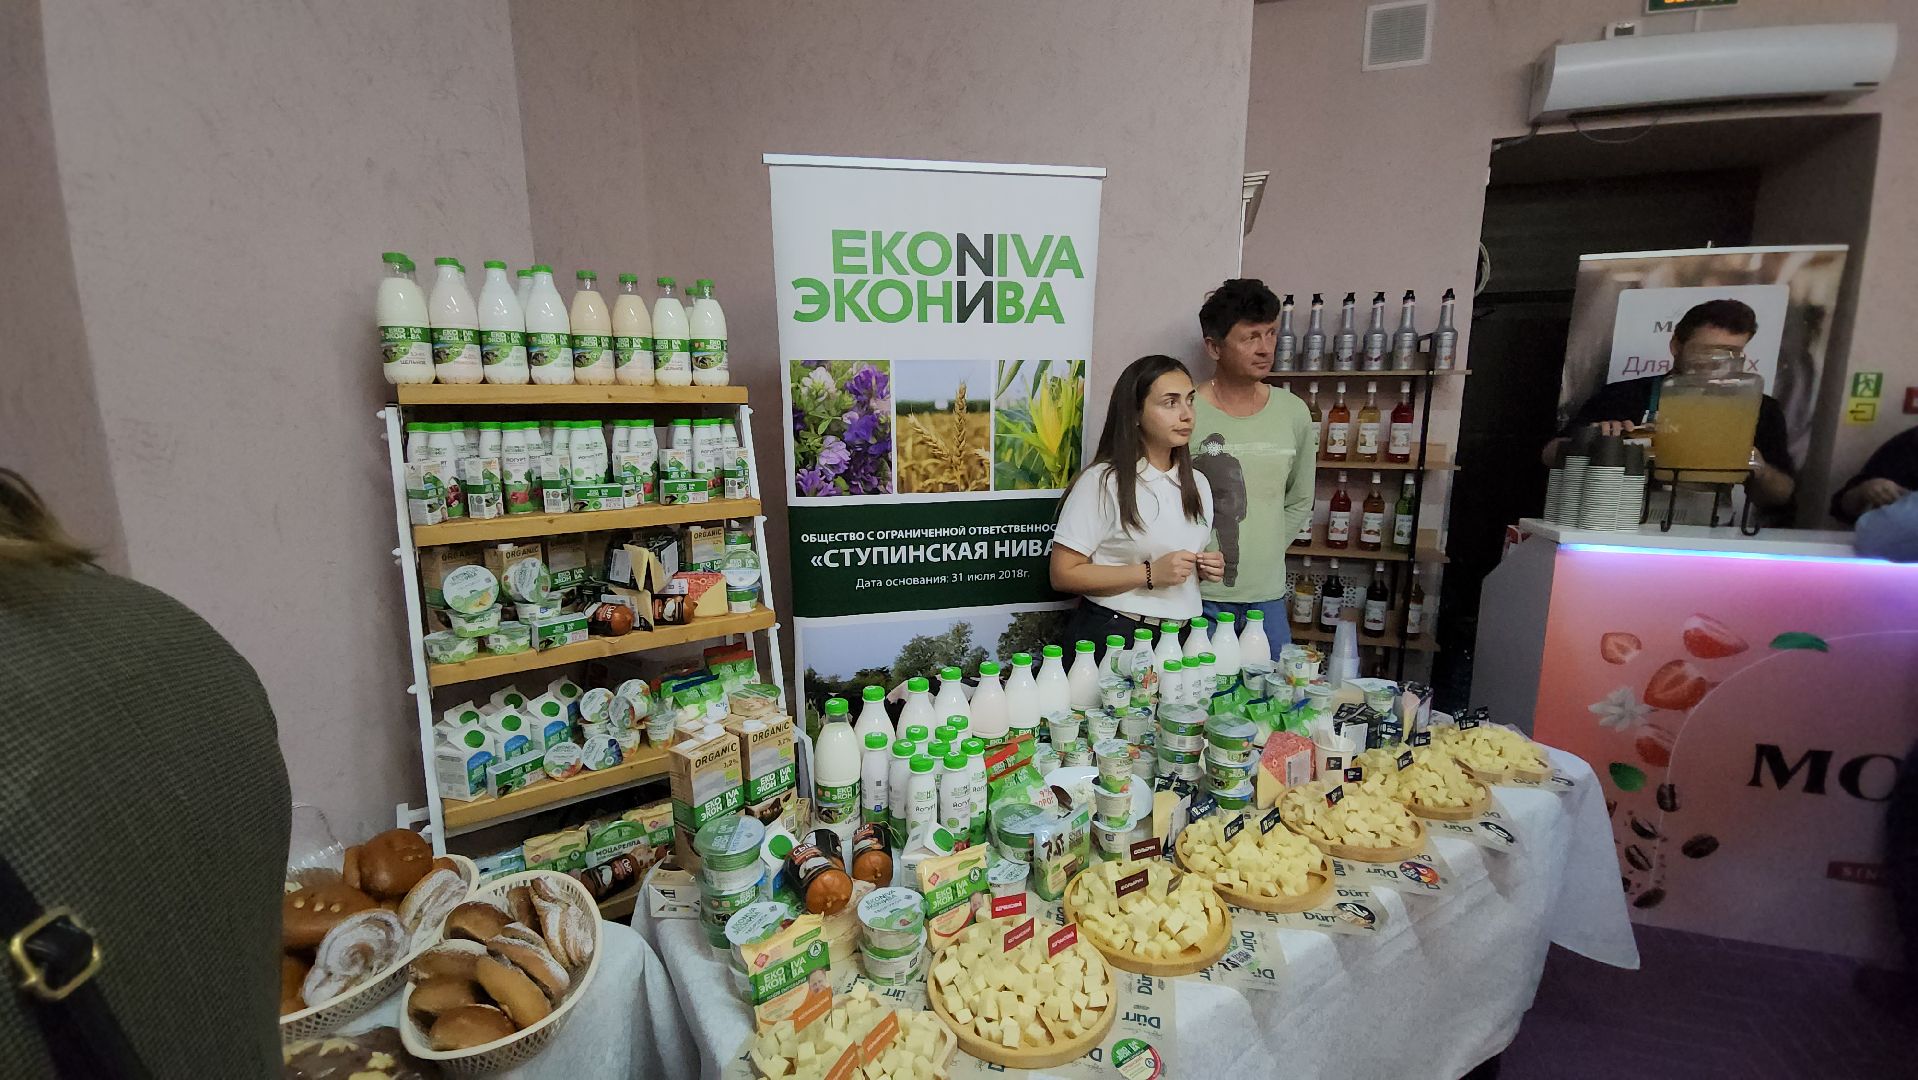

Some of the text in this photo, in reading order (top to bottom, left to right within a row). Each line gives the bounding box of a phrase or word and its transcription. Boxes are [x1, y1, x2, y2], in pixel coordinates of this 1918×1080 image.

[832, 229, 1085, 278] EKONIVA
[791, 277, 1065, 324] ЭКОНИВА
[694, 530, 722, 540] ORGANIC
[801, 532, 865, 544] ОБЩЕСТВО
[866, 530, 874, 540] С
[876, 524, 966, 540] ОГРАНИЧЕННОЙ
[811, 541, 988, 568] «СТУПИНСКАЯ
[856, 568, 1030, 590] Дата основания: 31 июля 2018г.
[752, 721, 790, 743] ORGANIC
[694, 742, 738, 768] ORGANIC
[756, 774, 790, 795] ЭКОНВА
[760, 766, 792, 786] EKOIVA
[705, 788, 740, 809] EKOIVA
[700, 797, 738, 822] ЭКОНВА
[596, 840, 641, 857] МОЦАРЕЛЛА
[1336, 889, 1370, 898] Dürr
[1302, 912, 1338, 923] Dürr
[1138, 974, 1153, 996] Dür
[1122, 1011, 1161, 1030] Dürr
